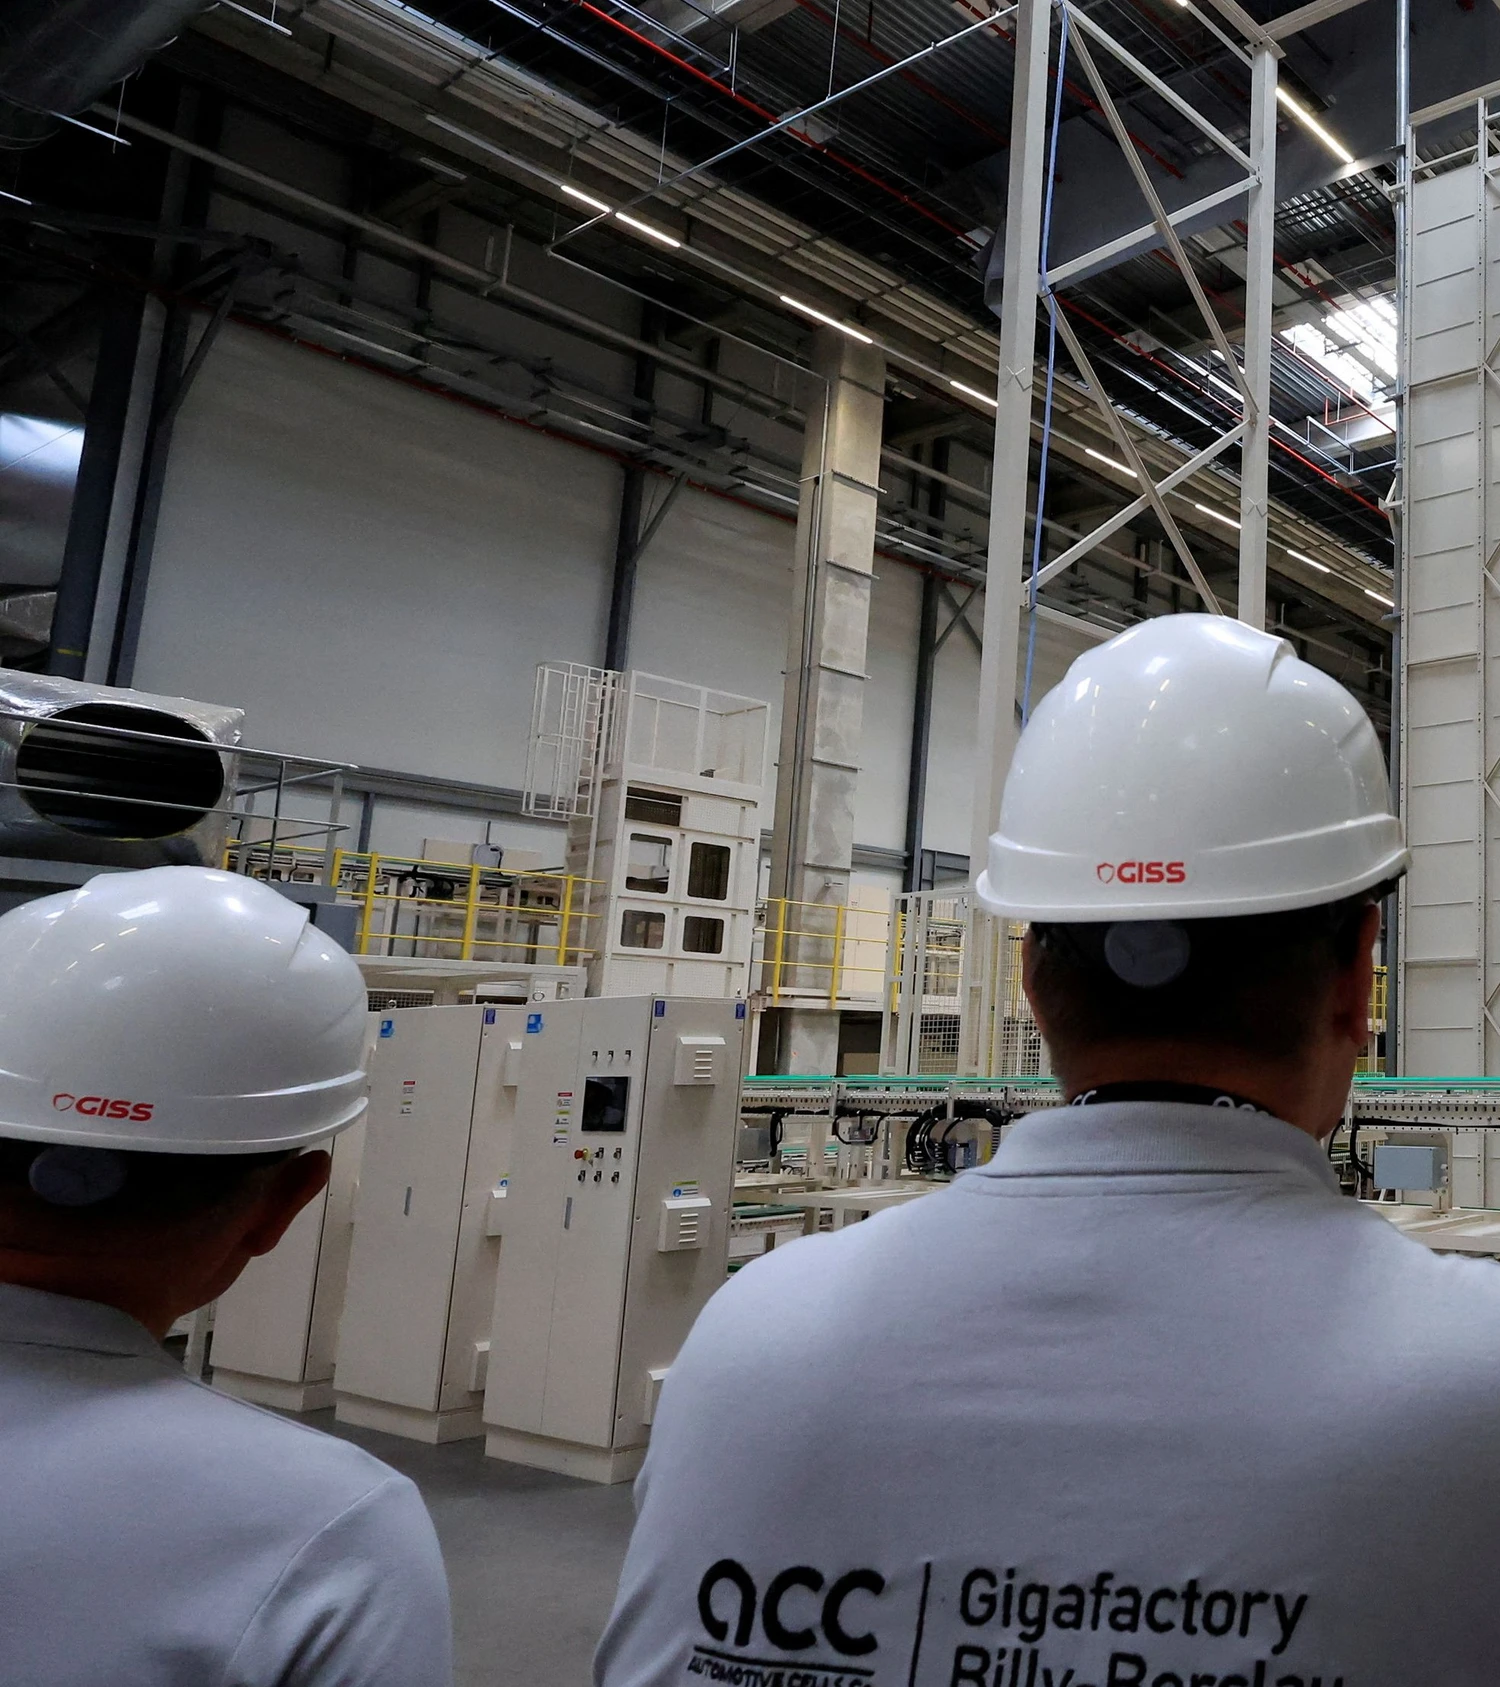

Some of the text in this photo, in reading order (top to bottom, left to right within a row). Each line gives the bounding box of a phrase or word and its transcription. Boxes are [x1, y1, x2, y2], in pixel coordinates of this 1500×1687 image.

[1117, 861, 1186, 883] GISS
[75, 1096, 154, 1121] GISS
[959, 1567, 1308, 1655] Gigafactory
[687, 1655, 785, 1687] AUTOMOTIVE
